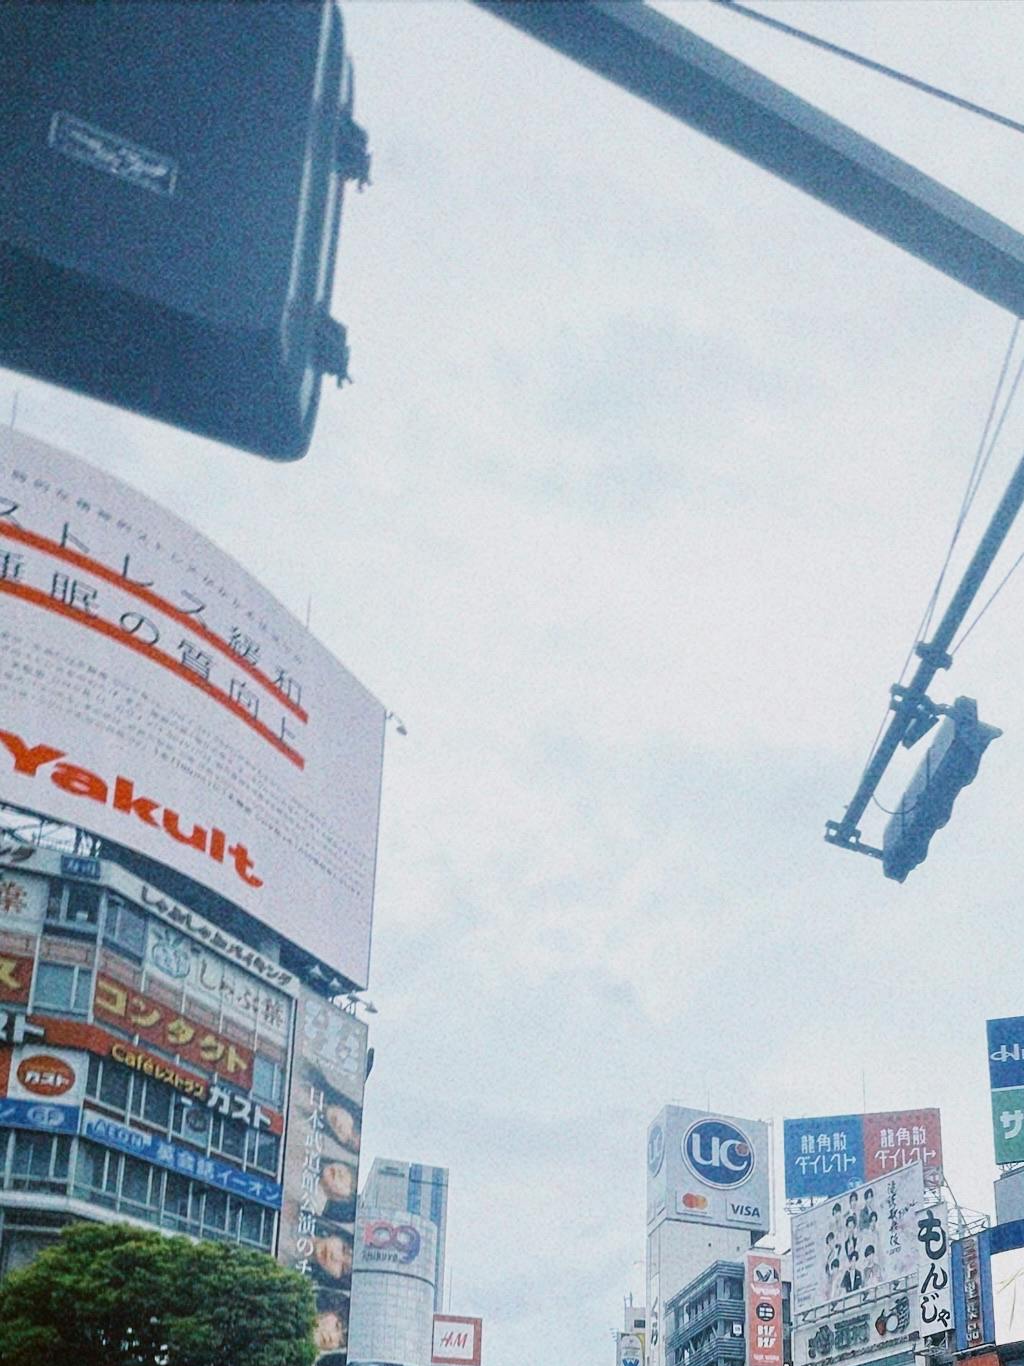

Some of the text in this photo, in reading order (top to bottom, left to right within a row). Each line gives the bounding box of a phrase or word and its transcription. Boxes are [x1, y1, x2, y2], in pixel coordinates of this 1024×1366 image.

[0, 496, 304, 707] ストレス緩和
[0, 729, 264, 889] Yakult
[96, 977, 247, 1075] コンタクト
[207, 1085, 272, 1129] ガスト
[691, 1133, 749, 1172] UC
[800, 1132, 848, 1153] 龍角散
[879, 1126, 927, 1148] 龍角散
[795, 1153, 857, 1176] ダイレクト
[731, 1203, 761, 1219] VISA
[363, 1220, 422, 1265] 109
[917, 1209, 952, 1329] もんじゃ
